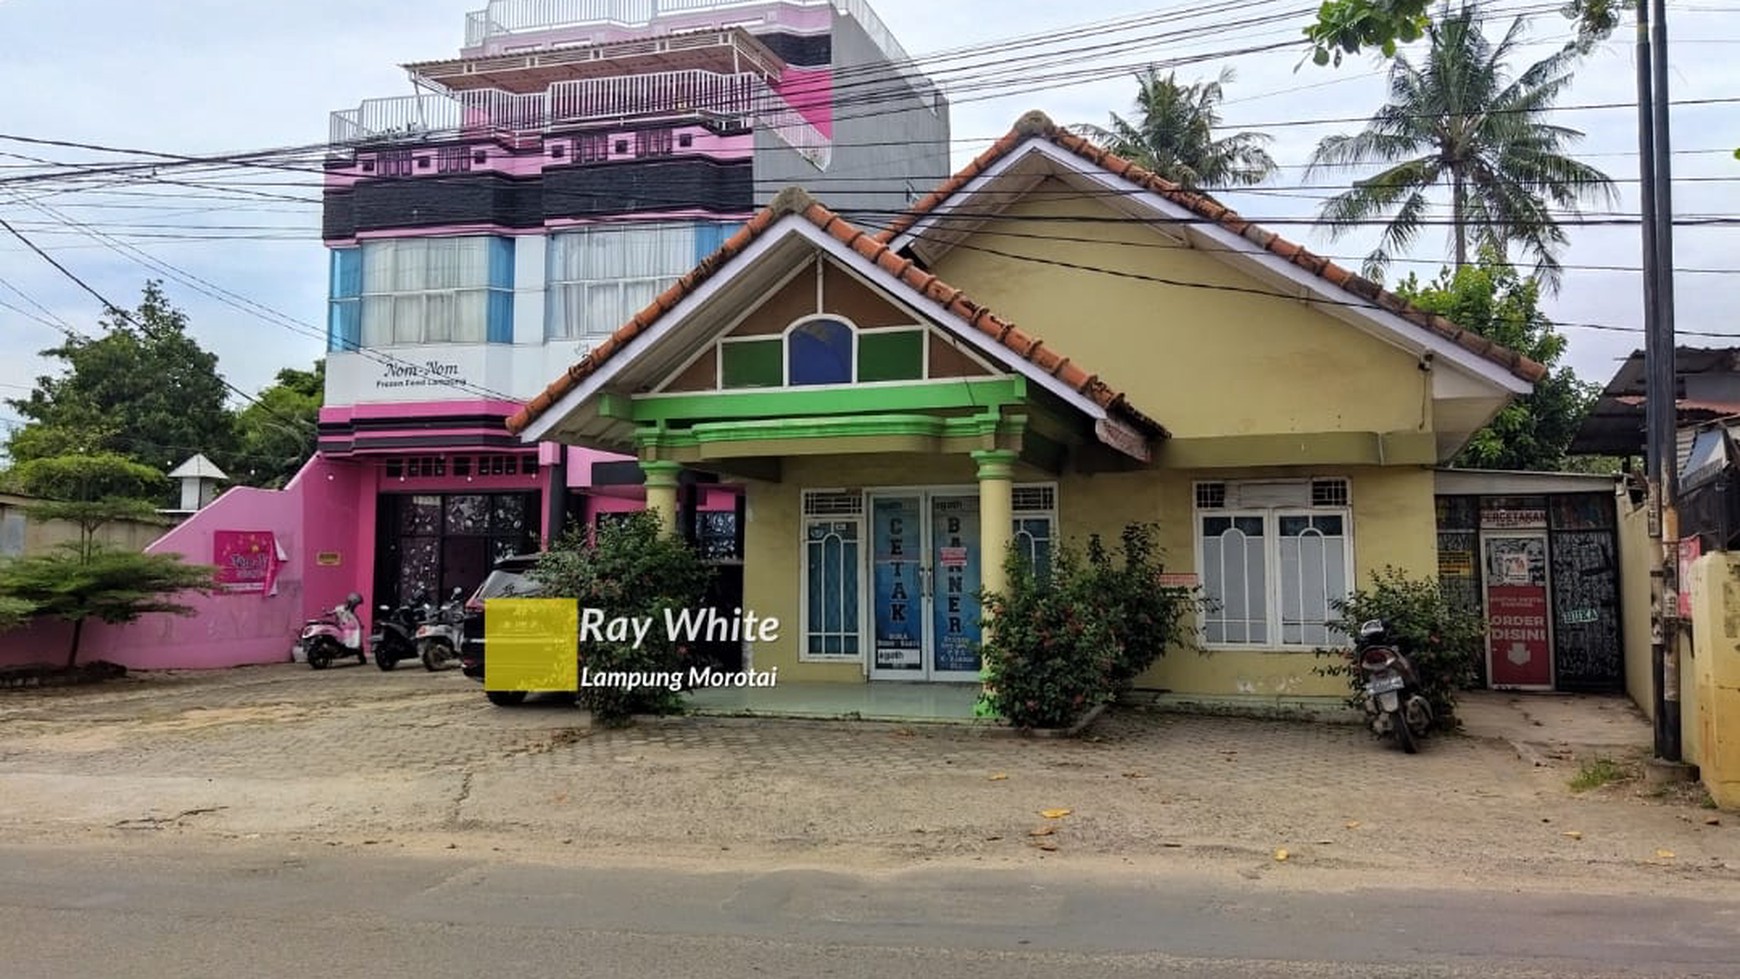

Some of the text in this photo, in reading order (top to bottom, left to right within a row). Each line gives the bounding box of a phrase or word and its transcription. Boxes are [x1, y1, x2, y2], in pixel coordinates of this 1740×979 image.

[384, 361, 458, 377] Nom-Nom
[376, 380, 404, 388] Frozen
[405, 379, 426, 387] Food
[889, 518, 907, 622] CETAK
[1491, 615, 1544, 626] ORDER
[1491, 629, 1546, 641] DISINI
